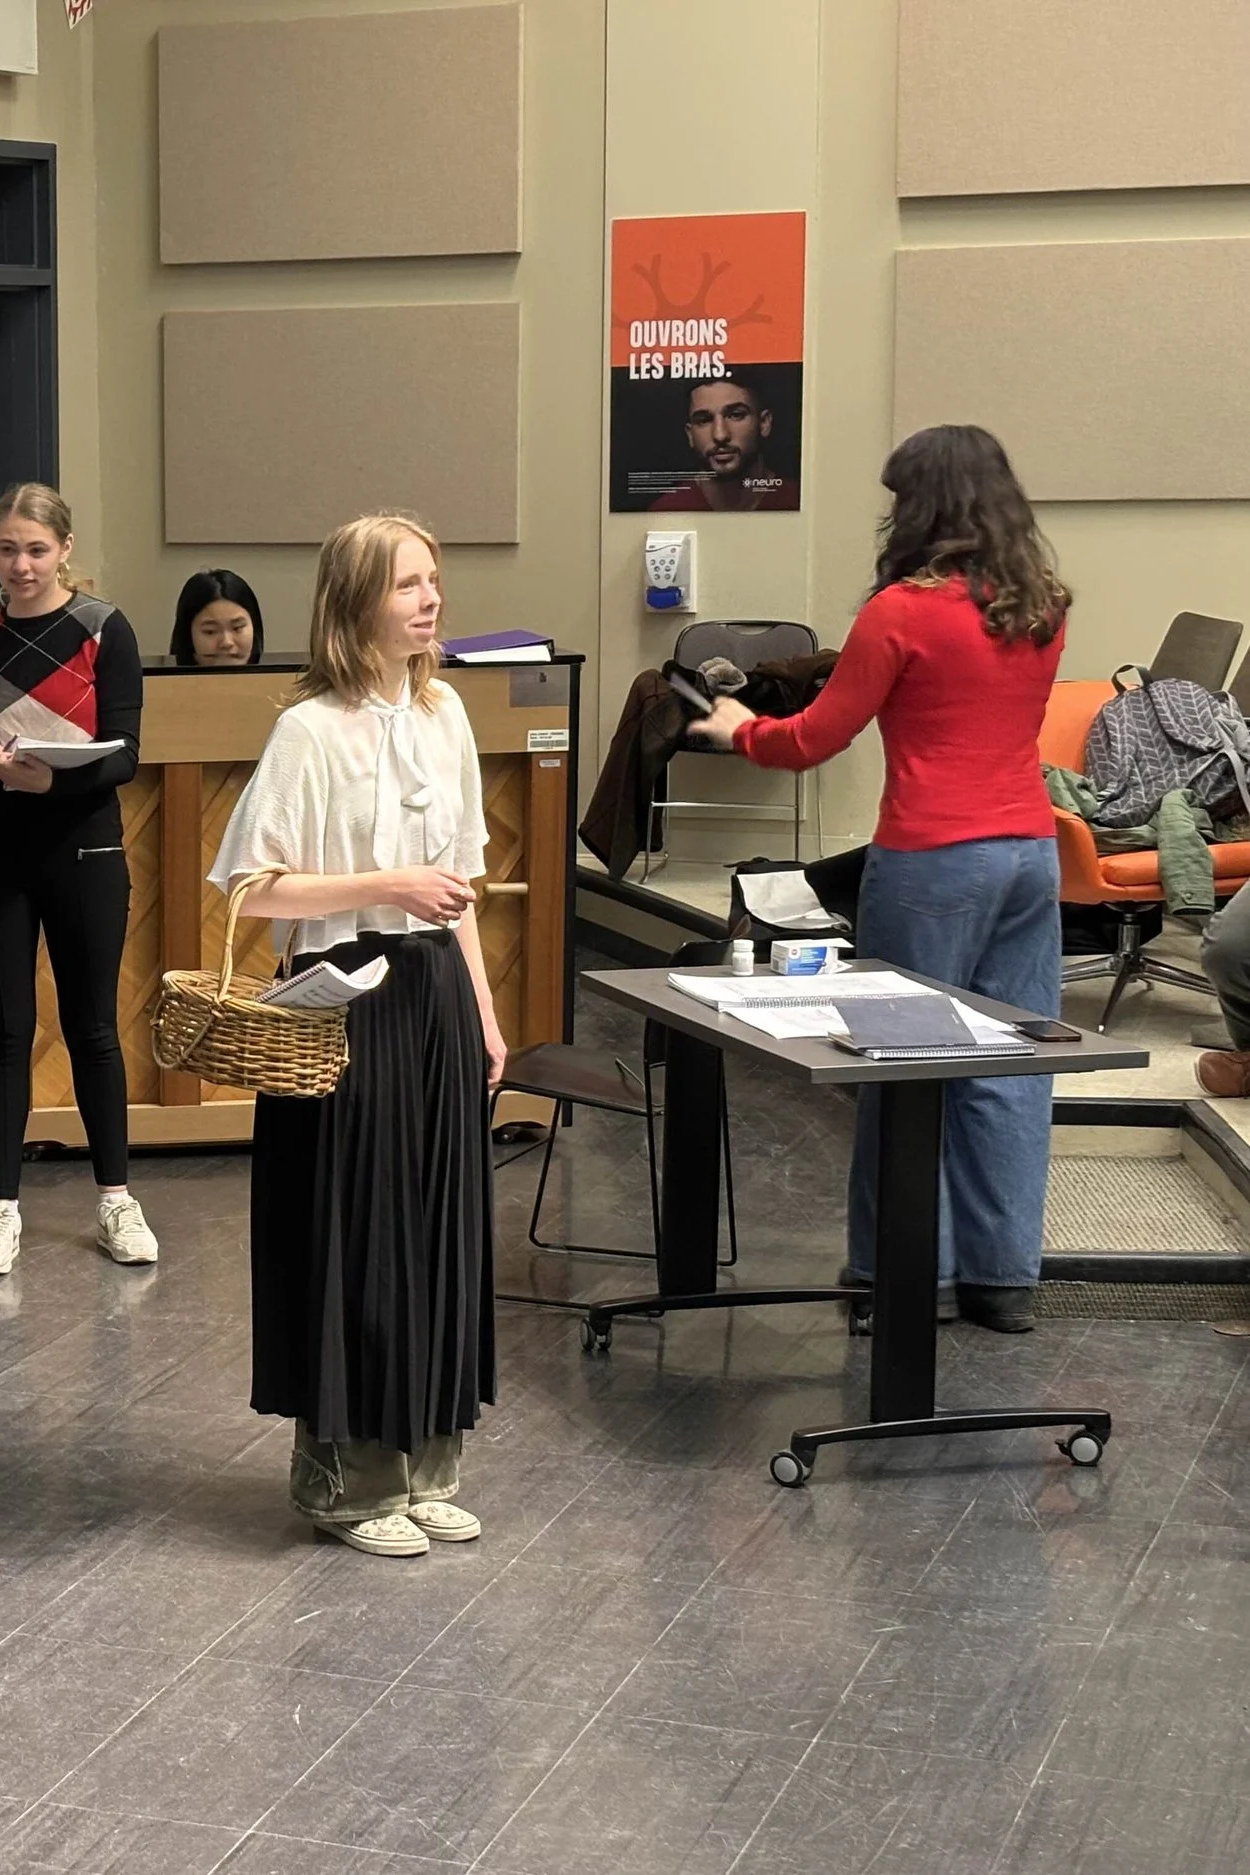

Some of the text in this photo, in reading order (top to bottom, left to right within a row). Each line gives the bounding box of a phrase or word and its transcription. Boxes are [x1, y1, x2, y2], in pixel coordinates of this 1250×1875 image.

[629, 318, 728, 348] OUVRONS
[629, 350, 733, 380] LES BRAS.
[752, 478, 783, 487] neuro
